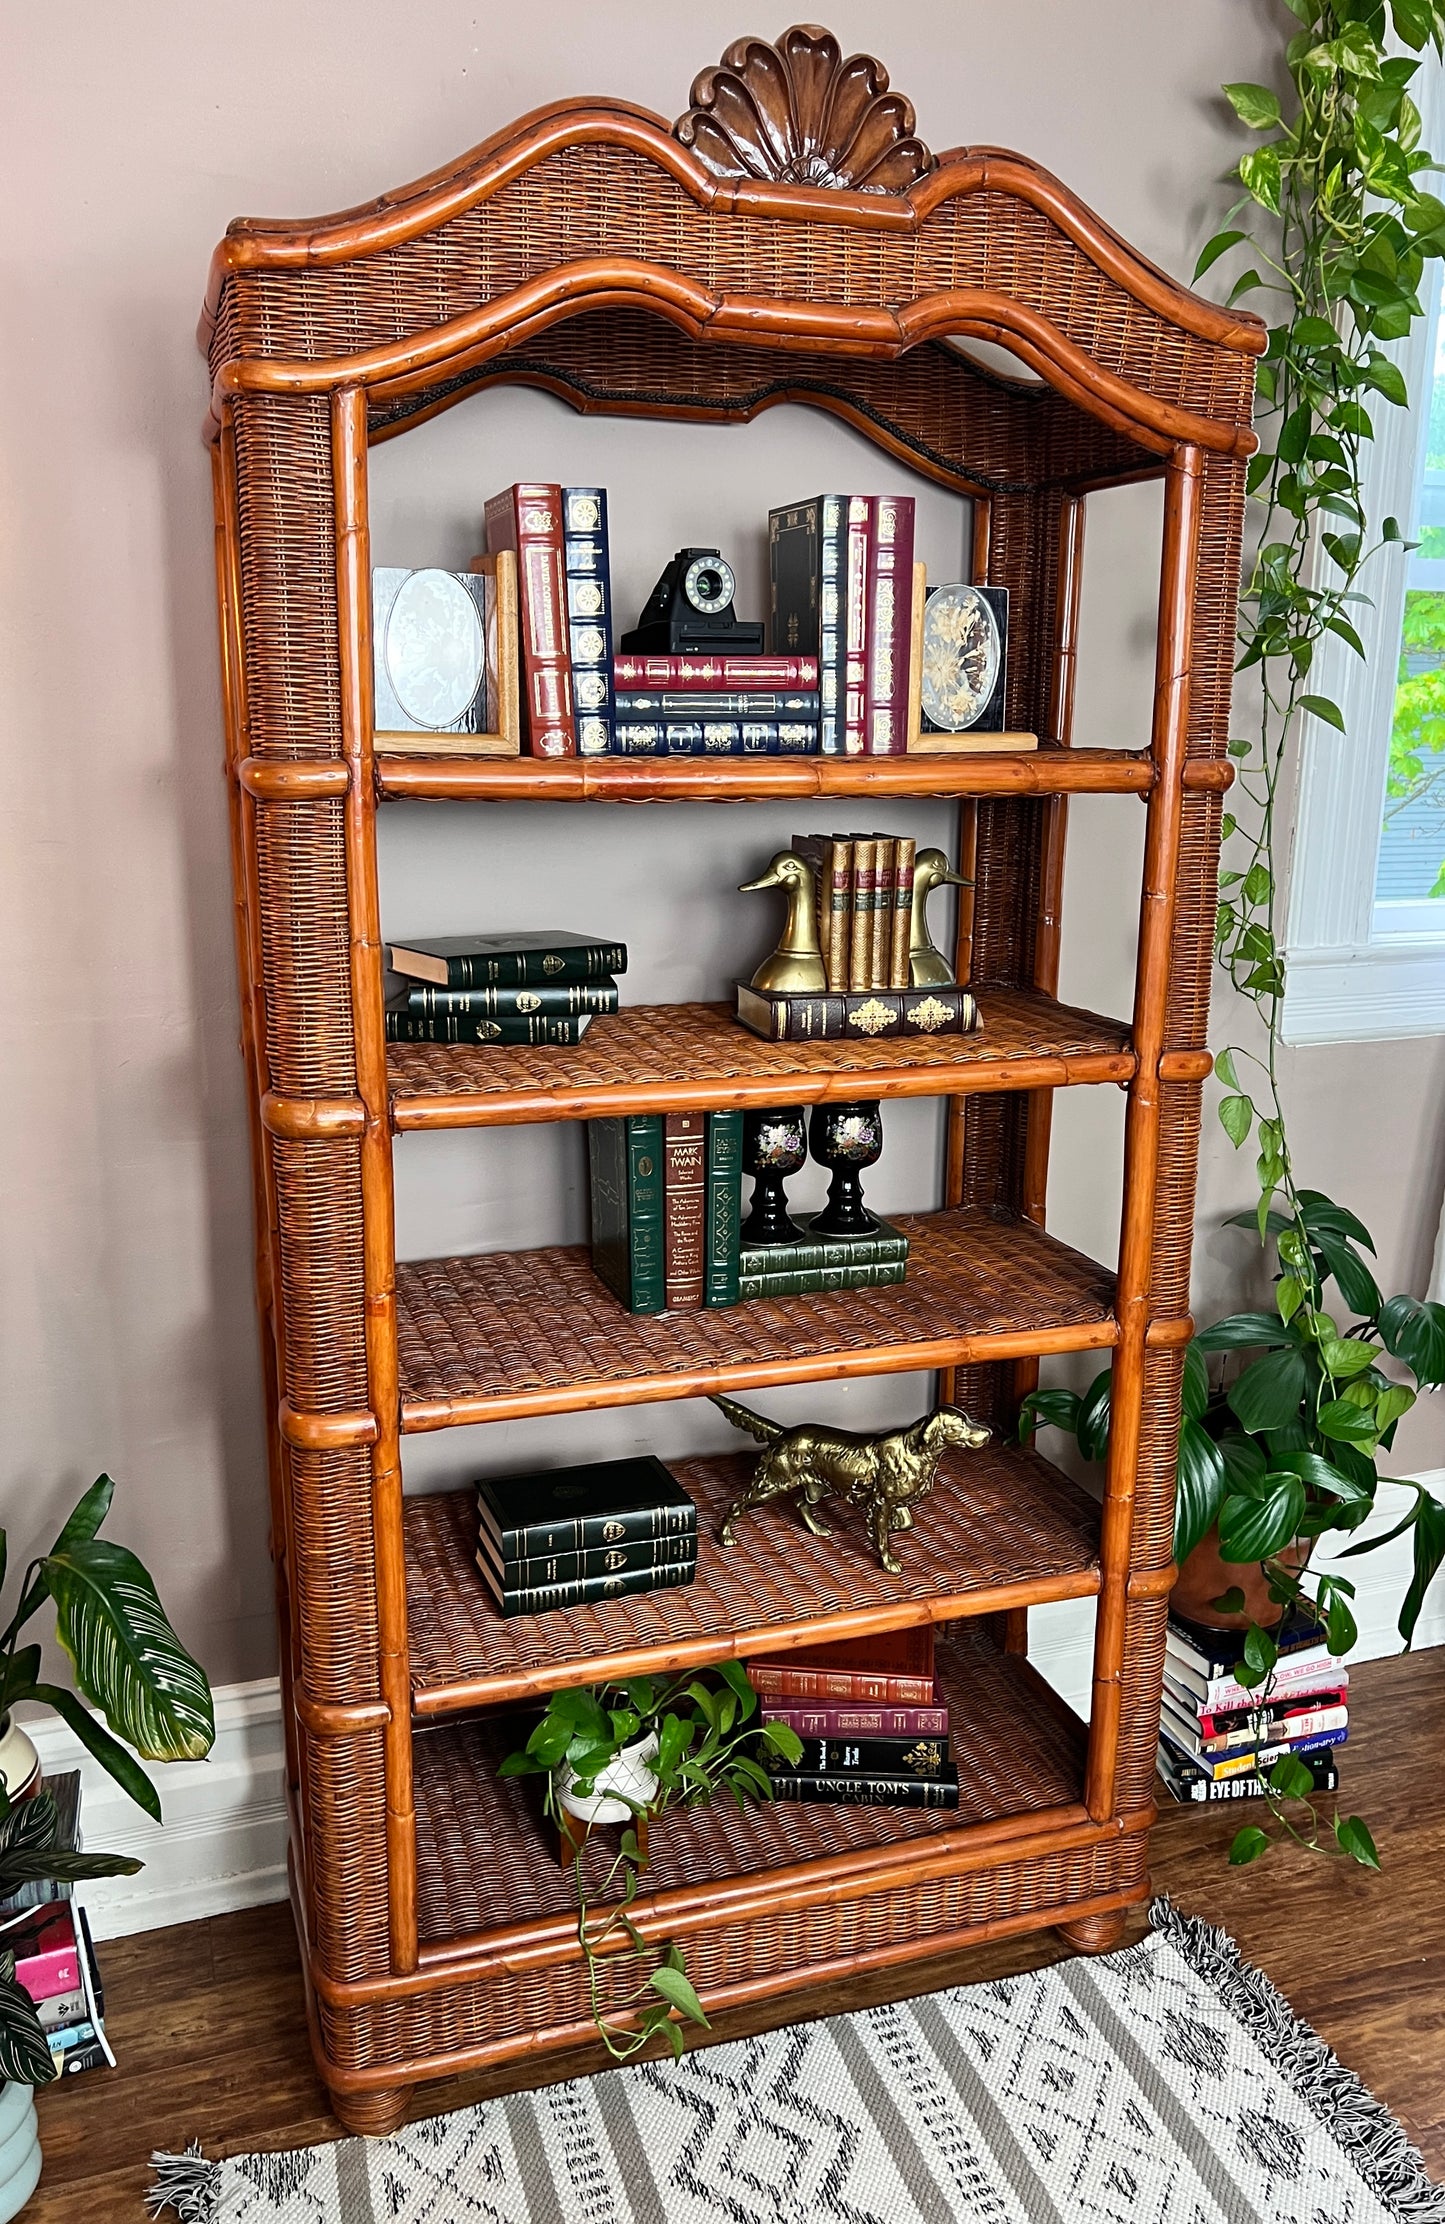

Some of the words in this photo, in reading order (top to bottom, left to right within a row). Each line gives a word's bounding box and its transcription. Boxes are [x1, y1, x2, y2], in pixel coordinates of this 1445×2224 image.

[541, 555, 550, 583] DAVID
[543, 584, 555, 646] COPPERFIELD
[673, 1147, 699, 1157] MARK
[670, 1156, 702, 1168] TWAIN
[1293, 1668, 1304, 1676] WE
[1306, 1664, 1316, 1672] GO
[1200, 1705, 1212, 1715] To
[1215, 1700, 1234, 1712] Kill
[1237, 1698, 1253, 1709] the
[819, 1746, 827, 1760] Book
[819, 1759, 827, 1770] The
[1223, 1761, 1256, 1776] Student
[815, 1780, 862, 1793] UNCLE
[867, 1781, 910, 1795] TOM'S
[1209, 1780, 1230, 1800] EYE
[1231, 1779, 1247, 1798] OF
[842, 1793, 885, 1804] CABIN
